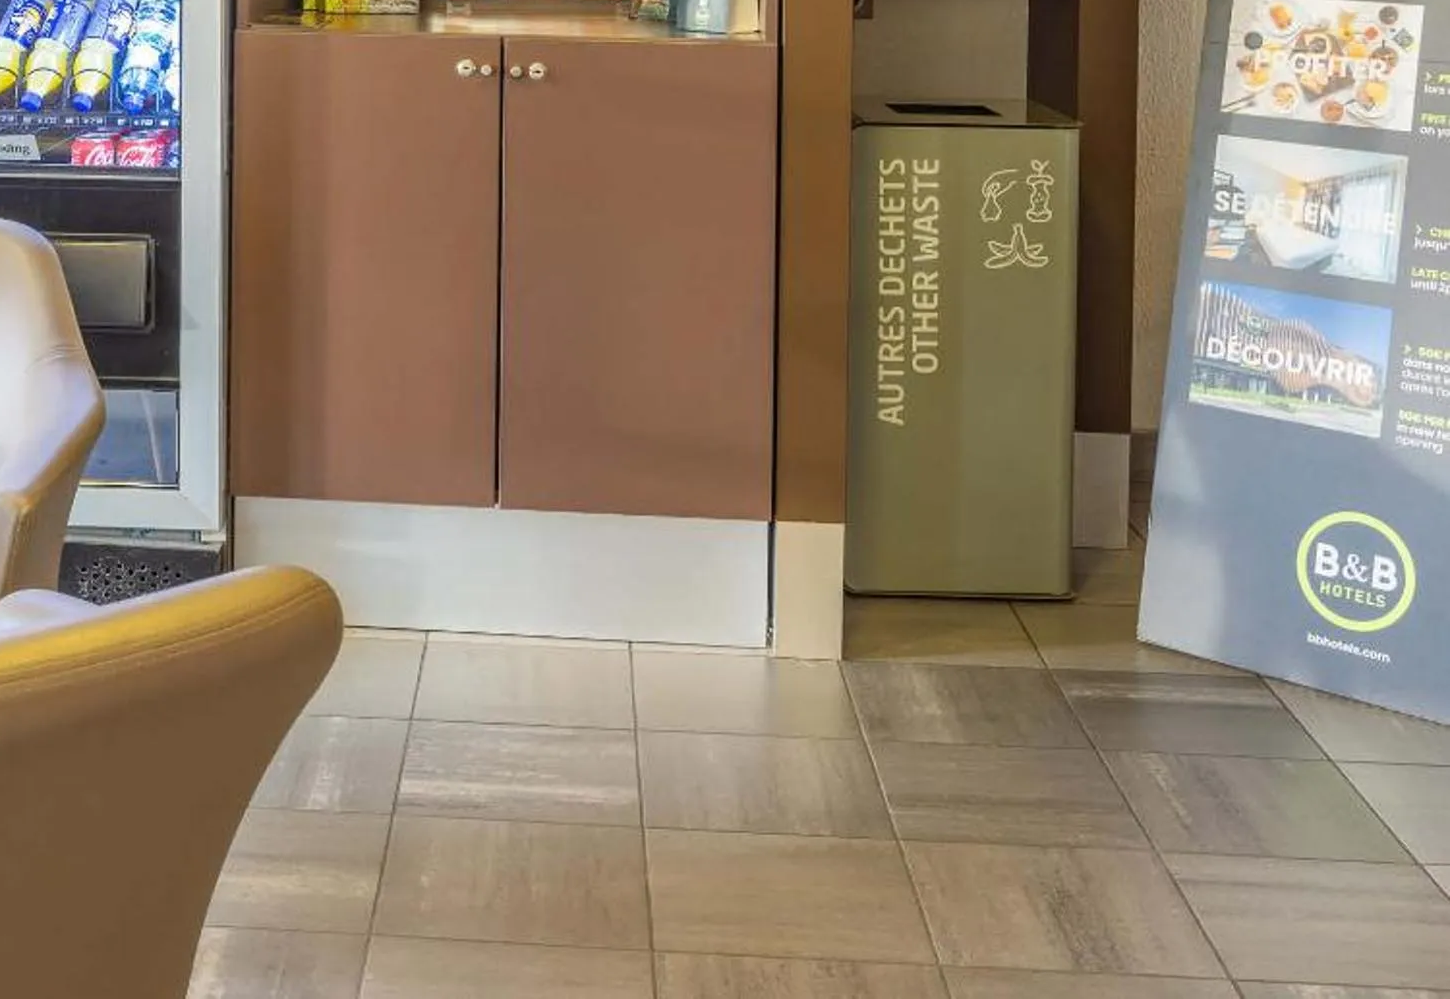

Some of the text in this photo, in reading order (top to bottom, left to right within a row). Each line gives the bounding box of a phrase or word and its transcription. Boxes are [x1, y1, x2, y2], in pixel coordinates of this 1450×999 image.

[1253, 49, 1389, 80] POFITER
[1212, 190, 1396, 235] SE DÉENE
[911, 158, 940, 374] OTHER WASTE
[877, 158, 907, 426] AUTRES DECHETS
[1205, 334, 1376, 386] DÉCOUVRIR
[1313, 541, 1398, 592] B&B
[1319, 580, 1387, 608] HOTELS
[1306, 632, 1391, 663] bbhotels.com
